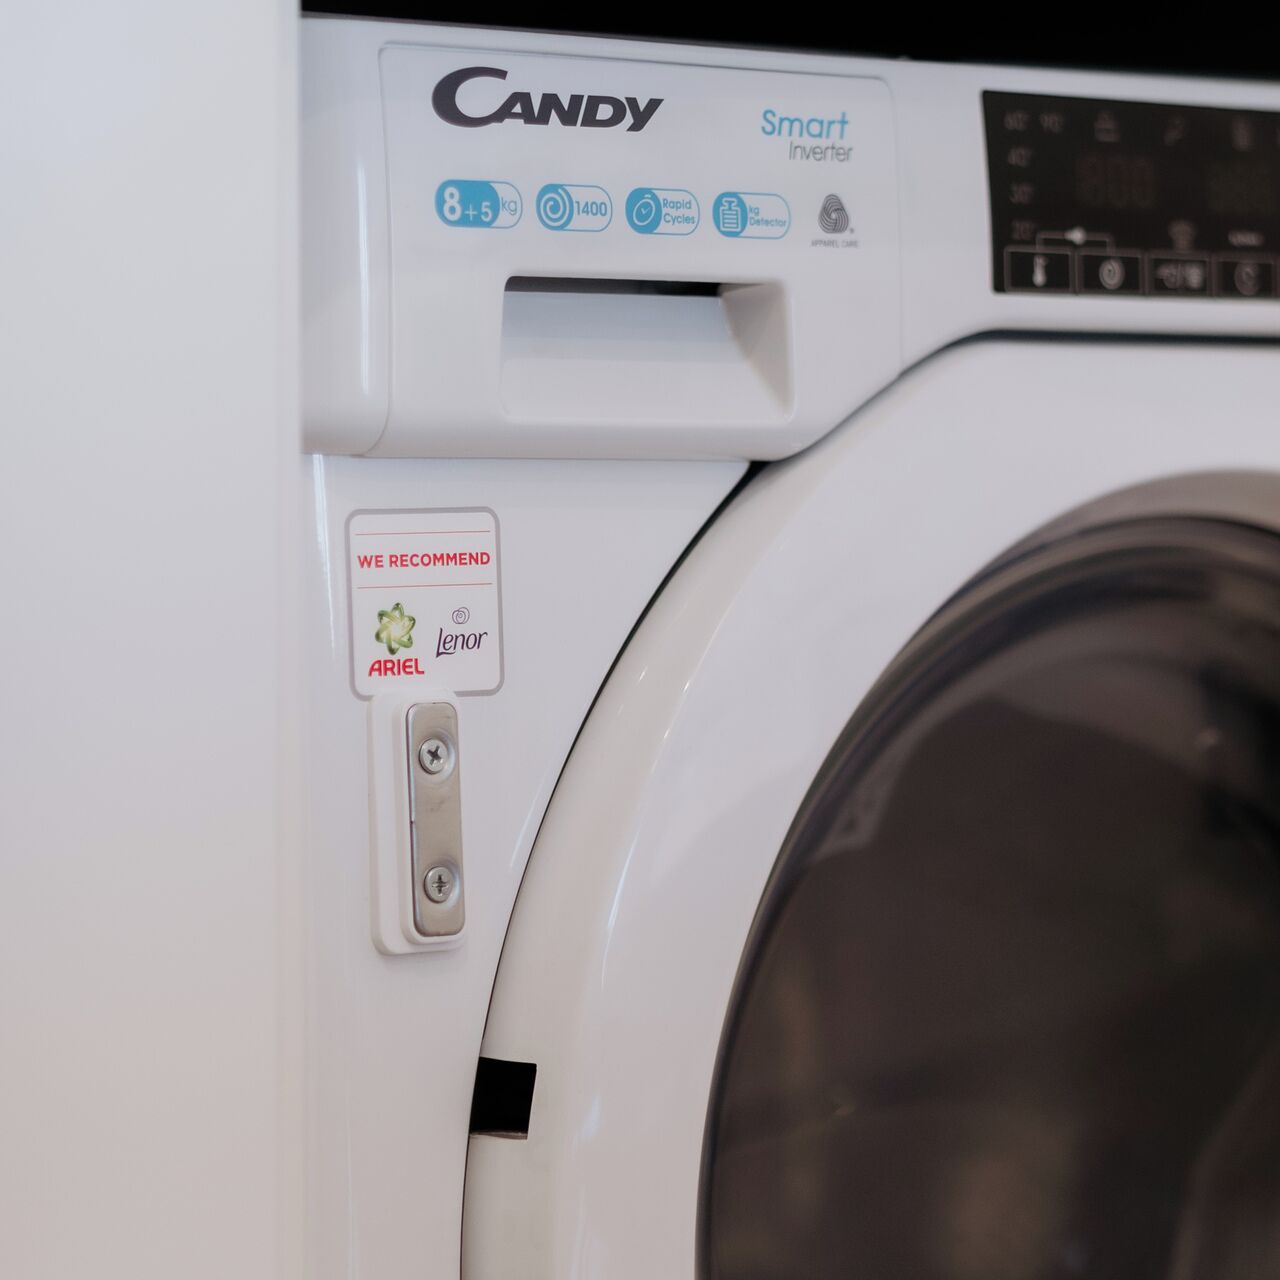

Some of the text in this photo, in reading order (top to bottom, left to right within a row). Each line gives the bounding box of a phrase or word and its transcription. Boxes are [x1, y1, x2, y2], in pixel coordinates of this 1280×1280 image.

[432, 66, 664, 132] CANDY
[761, 108, 849, 139] Smart
[789, 141, 853, 162] Inverter
[500, 197, 519, 217] kg
[574, 200, 608, 217] 1400
[662, 198, 692, 210] Rapid
[748, 204, 760, 216] kg
[663, 212, 696, 225] Cycles
[748, 216, 788, 228] Detector
[357, 551, 491, 569] WE RECOMMEND
[435, 627, 488, 658] Lenor
[368, 658, 425, 677] ARIEL
